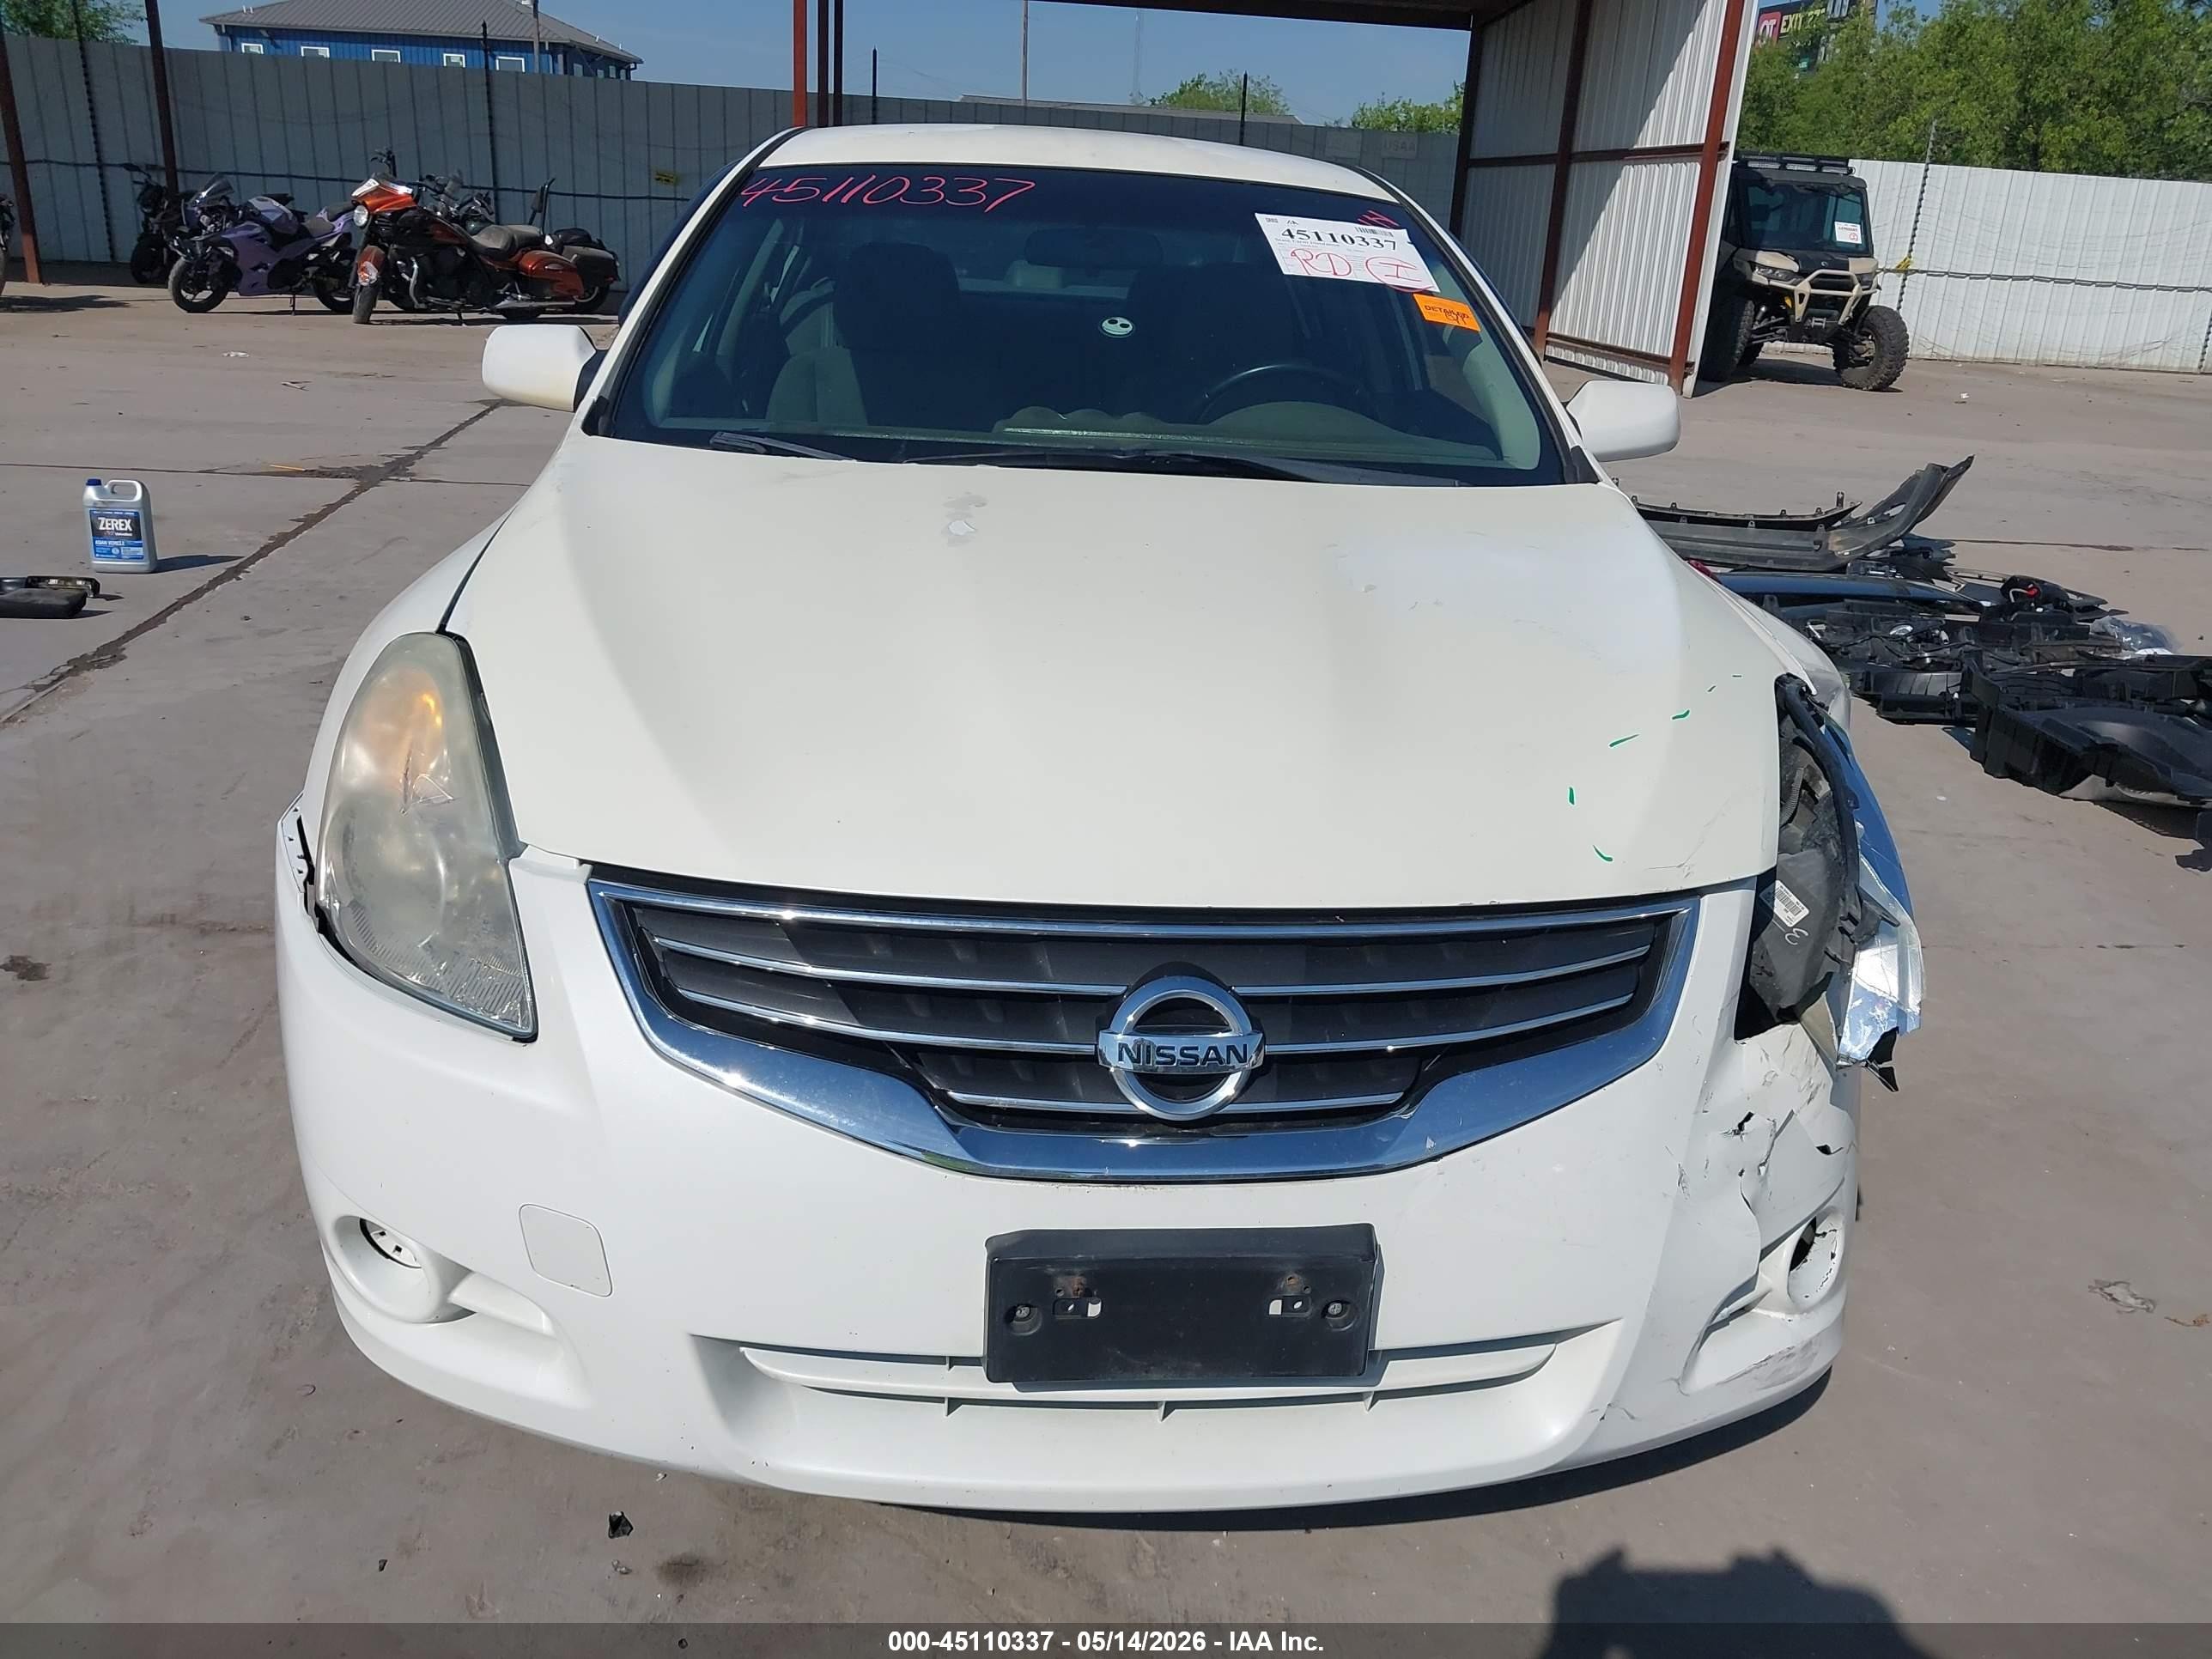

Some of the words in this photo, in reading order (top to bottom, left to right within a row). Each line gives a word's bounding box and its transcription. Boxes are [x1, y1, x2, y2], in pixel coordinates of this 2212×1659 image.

[741, 174, 1036, 214] 45110337
[1281, 228, 1396, 251] 45110337
[97, 517, 133, 532] ZEREX
[1117, 1042, 1249, 1066] NISSAN
